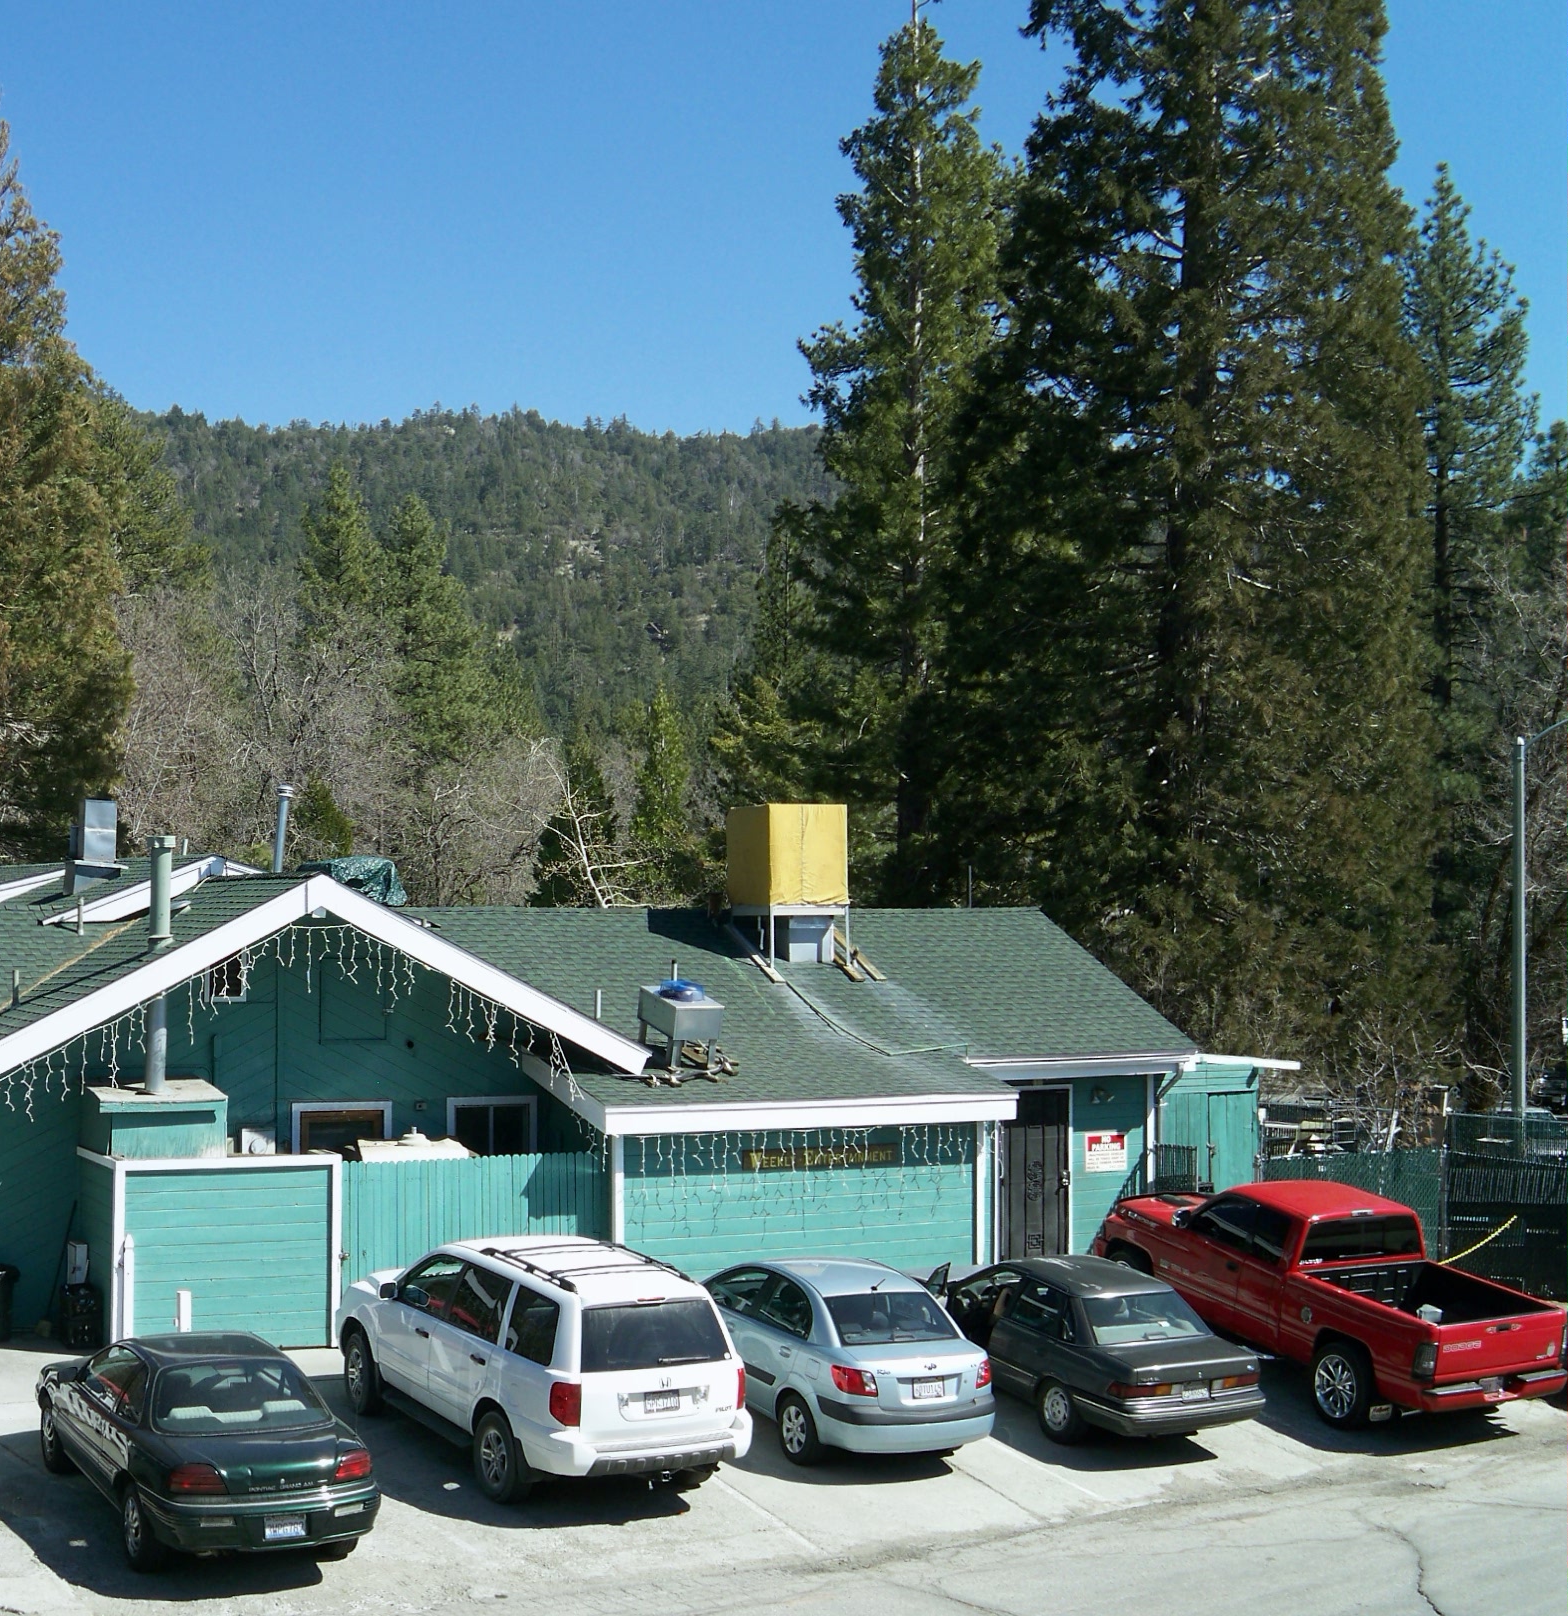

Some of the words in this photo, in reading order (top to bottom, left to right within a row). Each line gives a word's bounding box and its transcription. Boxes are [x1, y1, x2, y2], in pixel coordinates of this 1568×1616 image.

[1101, 1135, 1111, 1143] NO
[1091, 1142, 1121, 1151] PARKING
[1443, 1340, 1482, 1353] DODGE
[249, 1485, 276, 1493] PONTIAC
